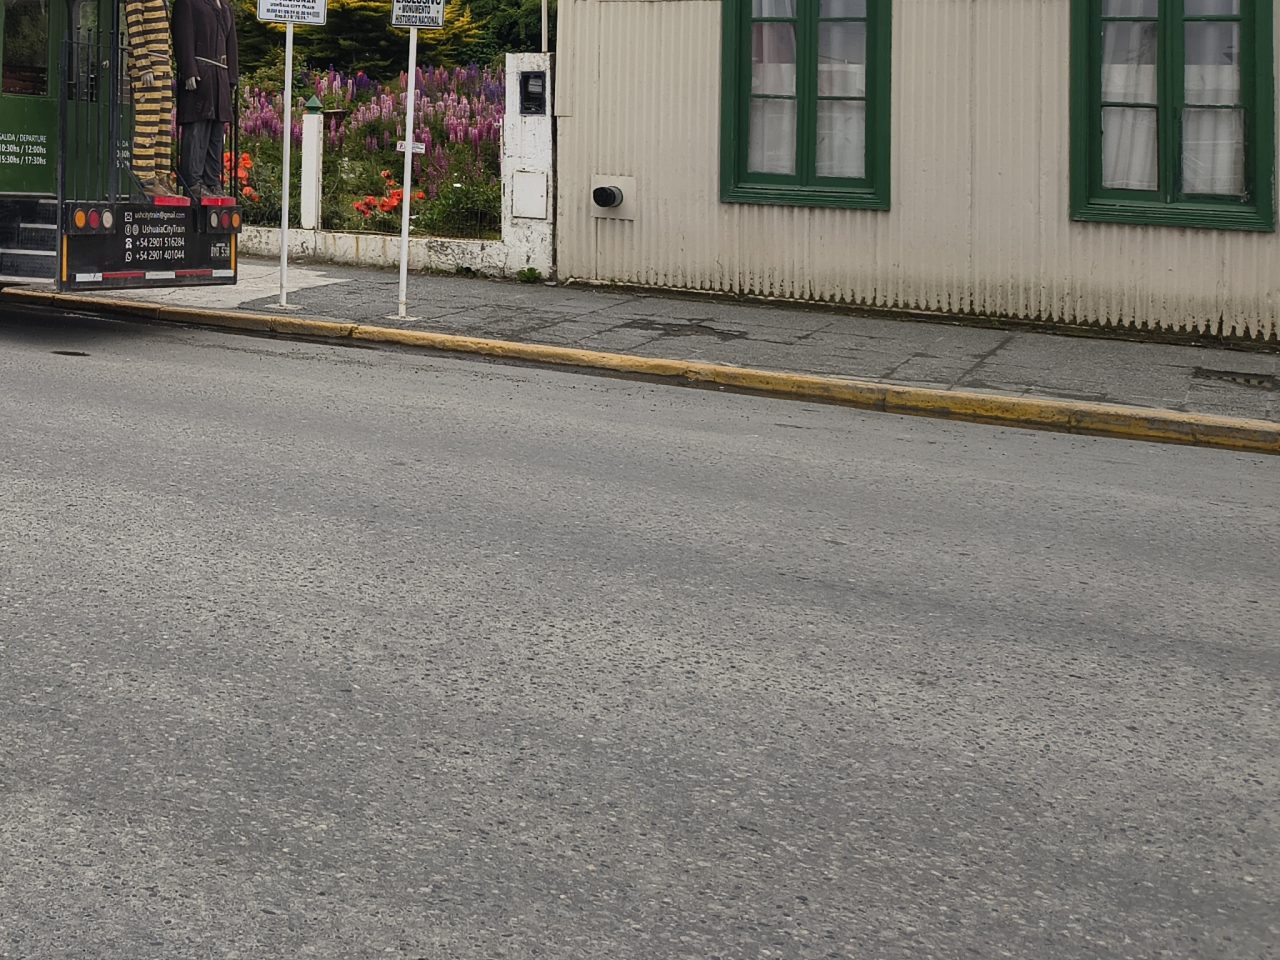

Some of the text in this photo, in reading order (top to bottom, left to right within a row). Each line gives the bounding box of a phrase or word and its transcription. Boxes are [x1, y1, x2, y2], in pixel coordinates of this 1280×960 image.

[402, 4, 430, 14] MONUMENTO
[20, 134, 46, 143] DEPARTURE
[25, 145, 46, 153] 12:00hs
[25, 156, 46, 165] 17:30hs
[135, 212, 185, 220] ushcitytrain@gmail.com
[142, 224, 185, 235] UshuaiaCityTrain
[136, 237, 184, 247] +54 2901 516284
[136, 250, 184, 260] +54 2901 401044
